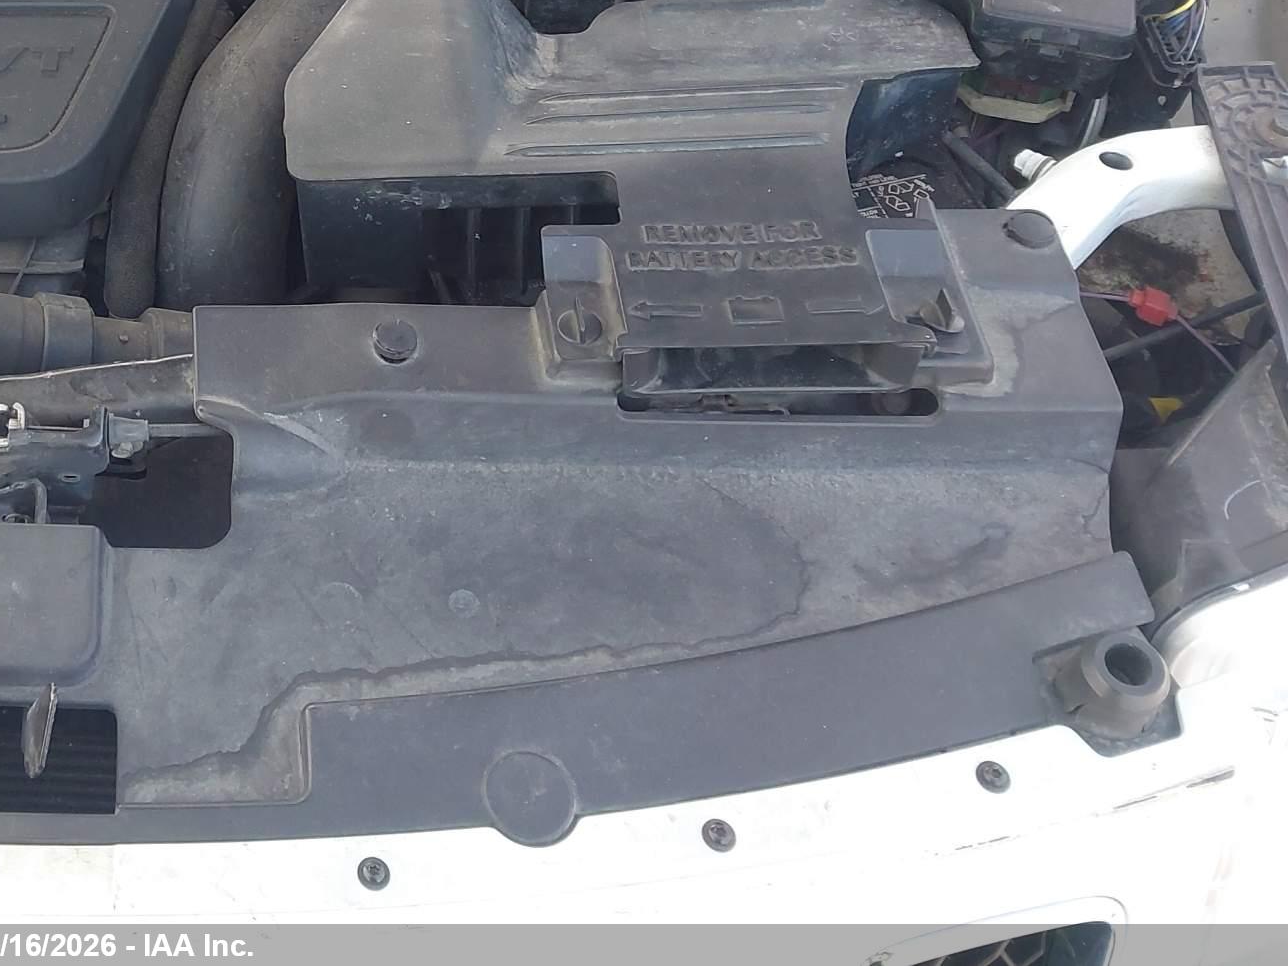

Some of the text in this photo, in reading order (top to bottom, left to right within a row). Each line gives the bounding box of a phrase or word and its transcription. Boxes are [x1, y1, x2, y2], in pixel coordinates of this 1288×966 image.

[642, 220, 823, 246] REMOVE FOR
[626, 247, 861, 272] BATTERY ACCESS
